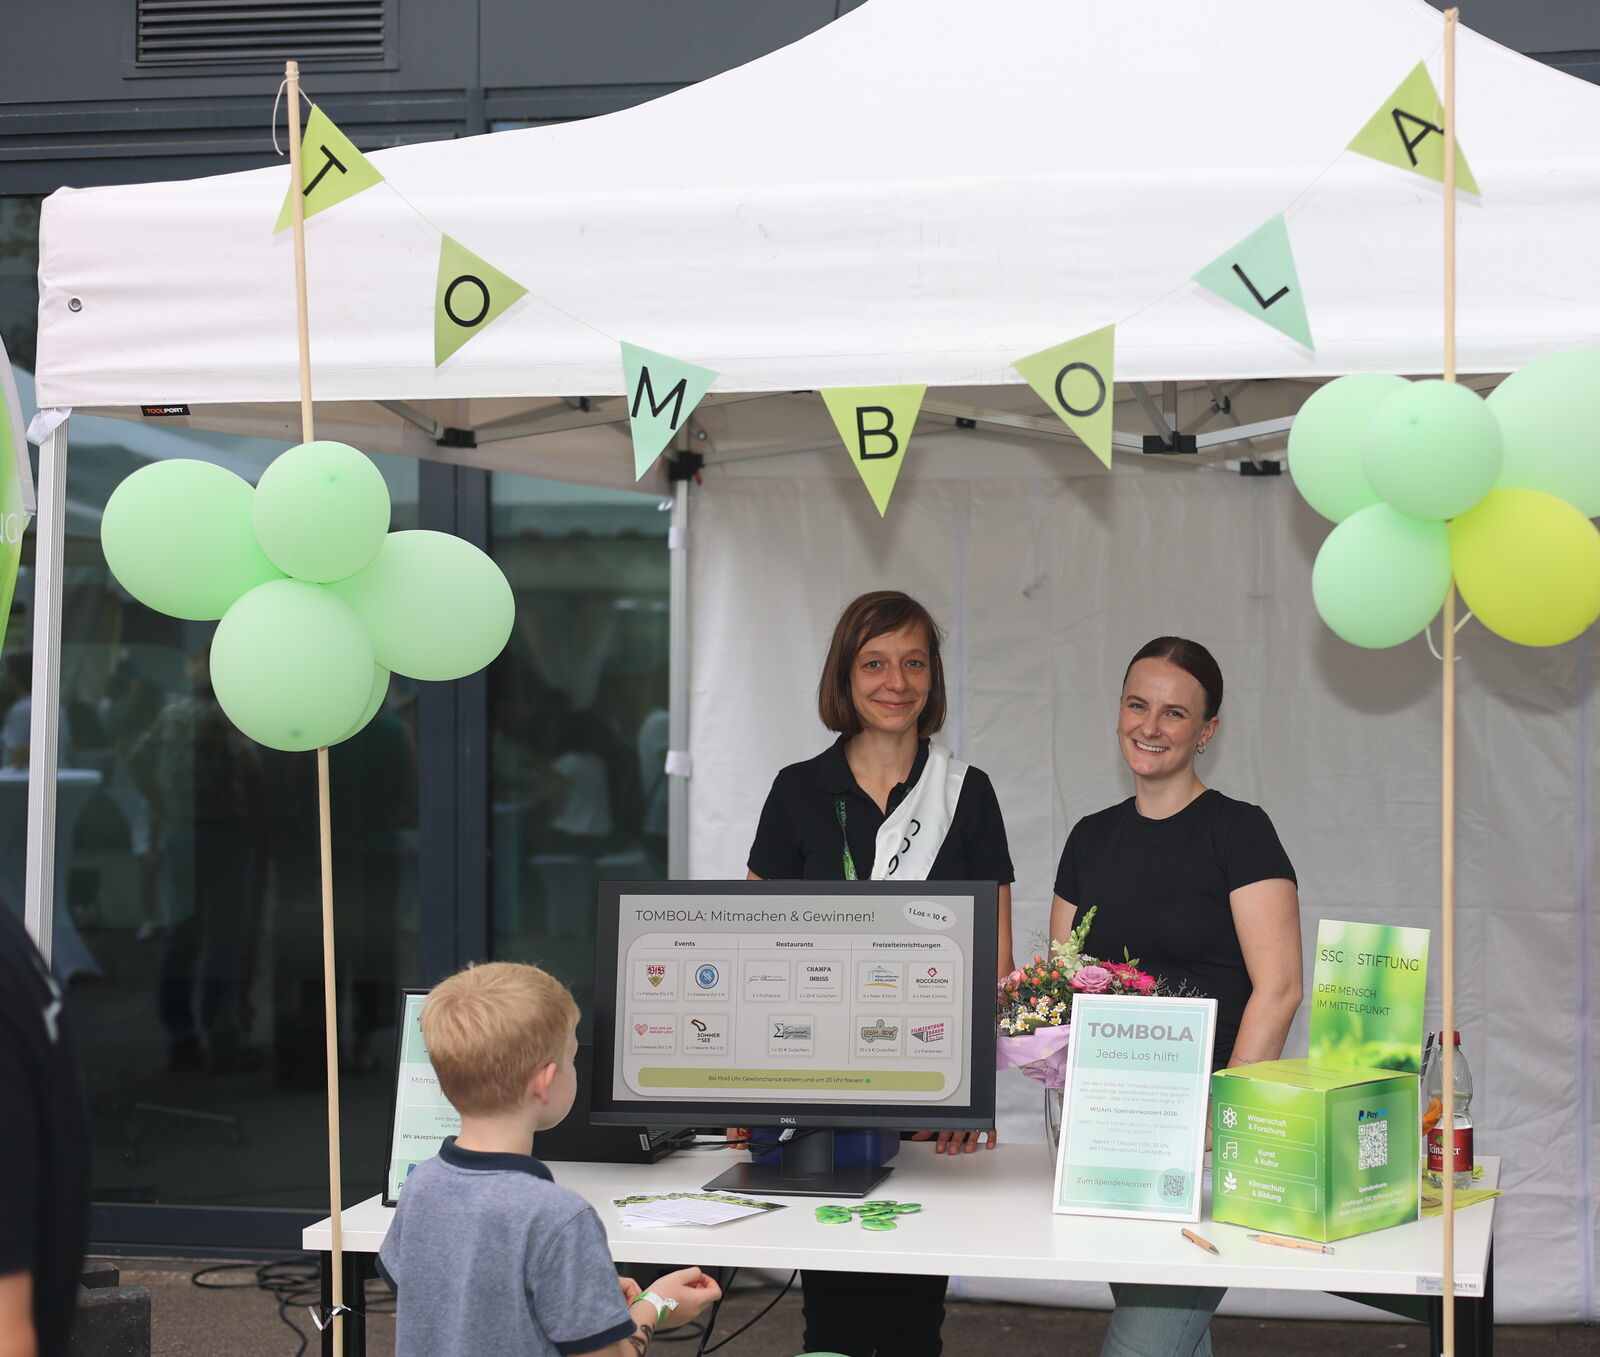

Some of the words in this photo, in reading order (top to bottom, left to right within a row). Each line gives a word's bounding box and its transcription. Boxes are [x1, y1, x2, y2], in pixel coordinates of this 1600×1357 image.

[635, 910, 707, 922] TOMBOLA:
[711, 910, 787, 922] Mitmachen
[790, 910, 799, 922] &
[803, 911, 875, 922] Gewinnen!
[913, 909, 925, 917] Los
[933, 913, 941, 921] 10
[1320, 949, 1344, 963] SSC
[1357, 954, 1419, 971] STIFTUNG
[1318, 983, 1336, 994] DER
[1338, 985, 1377, 998] MENSCH
[1316, 999, 1326, 1008] IM
[1329, 1001, 1390, 1016] MITTELPUNKT
[1088, 1022, 1194, 1042] TOMBOLA
[1096, 1049, 1128, 1060] Jedes
[1132, 1051, 1150, 1061] Los
[1153, 1051, 1179, 1062] hilft!
[1114, 1108, 1161, 1116] Spendenkonzert
[1247, 1114, 1287, 1127] Wissenschaft
[1253, 1125, 1286, 1137] Forschung
[1076, 1177, 1093, 1185] Zum
[1248, 1180, 1285, 1193] Klimaschutz
